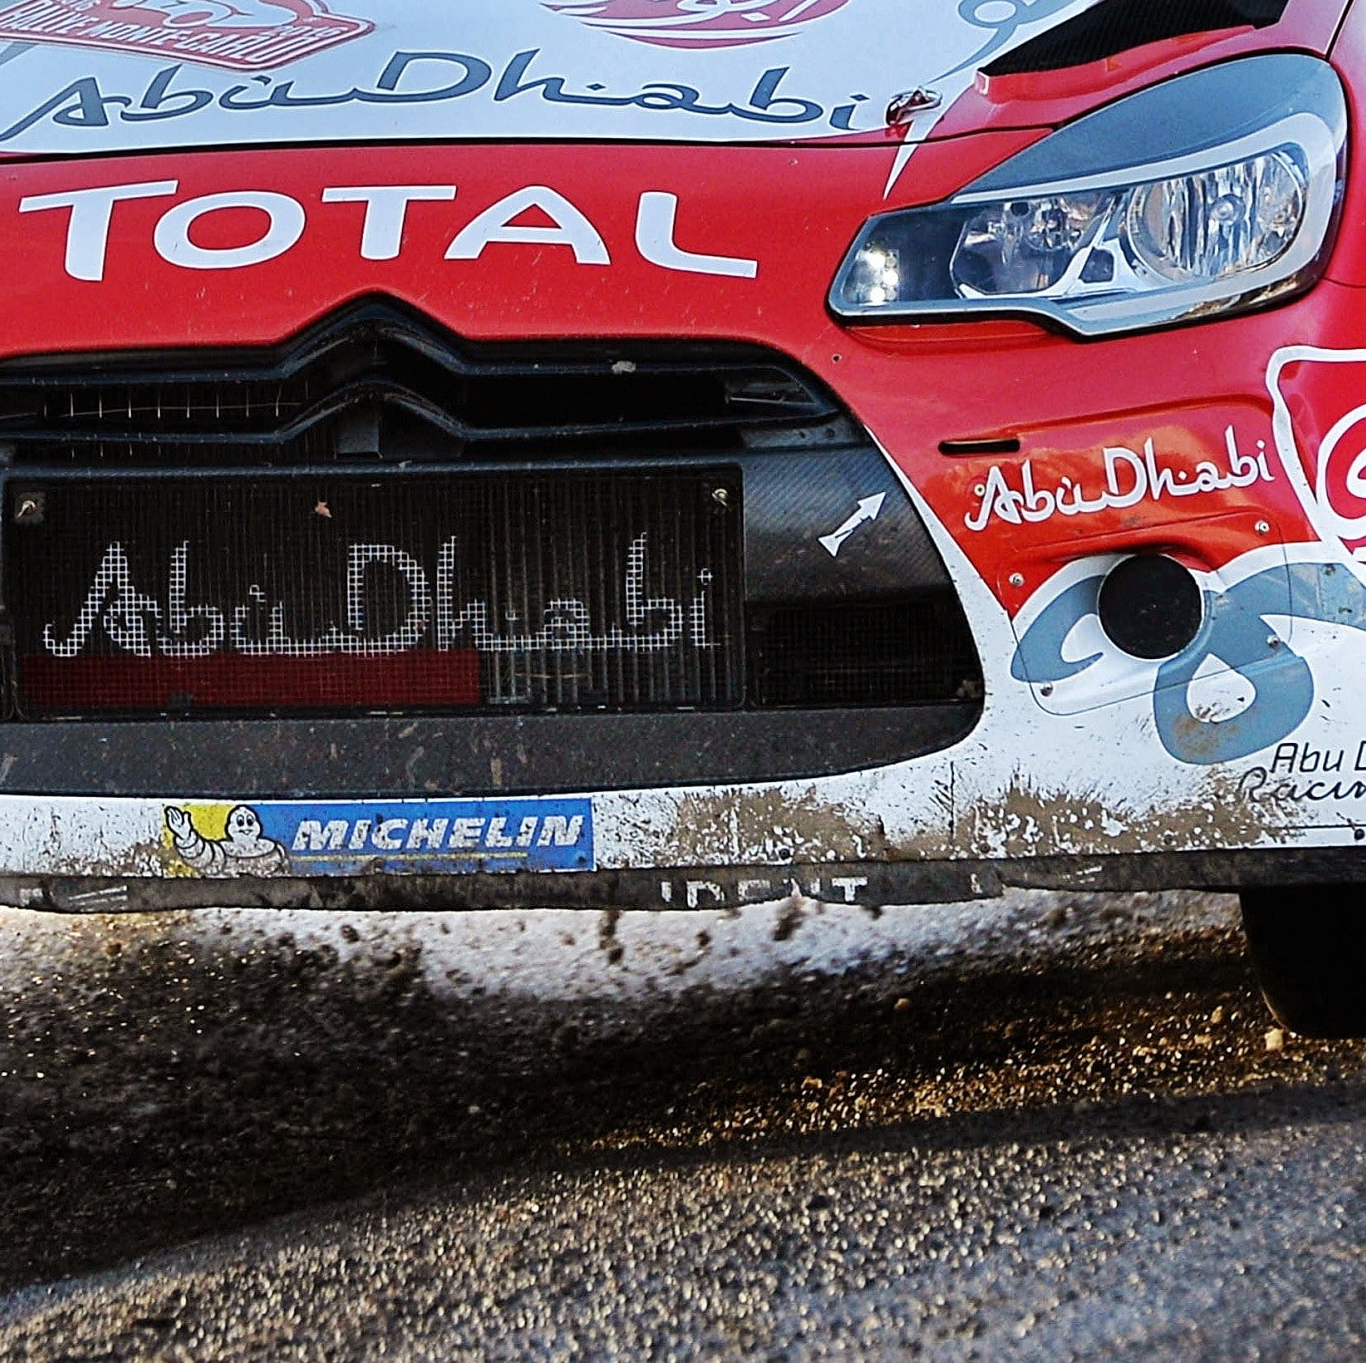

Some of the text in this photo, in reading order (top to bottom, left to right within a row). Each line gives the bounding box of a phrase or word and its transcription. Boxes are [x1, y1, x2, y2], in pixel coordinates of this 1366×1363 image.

[18, 179, 758, 282] TOTAL
[1269, 741, 1344, 774] Abu
[290, 814, 585, 852] MICHELIN
